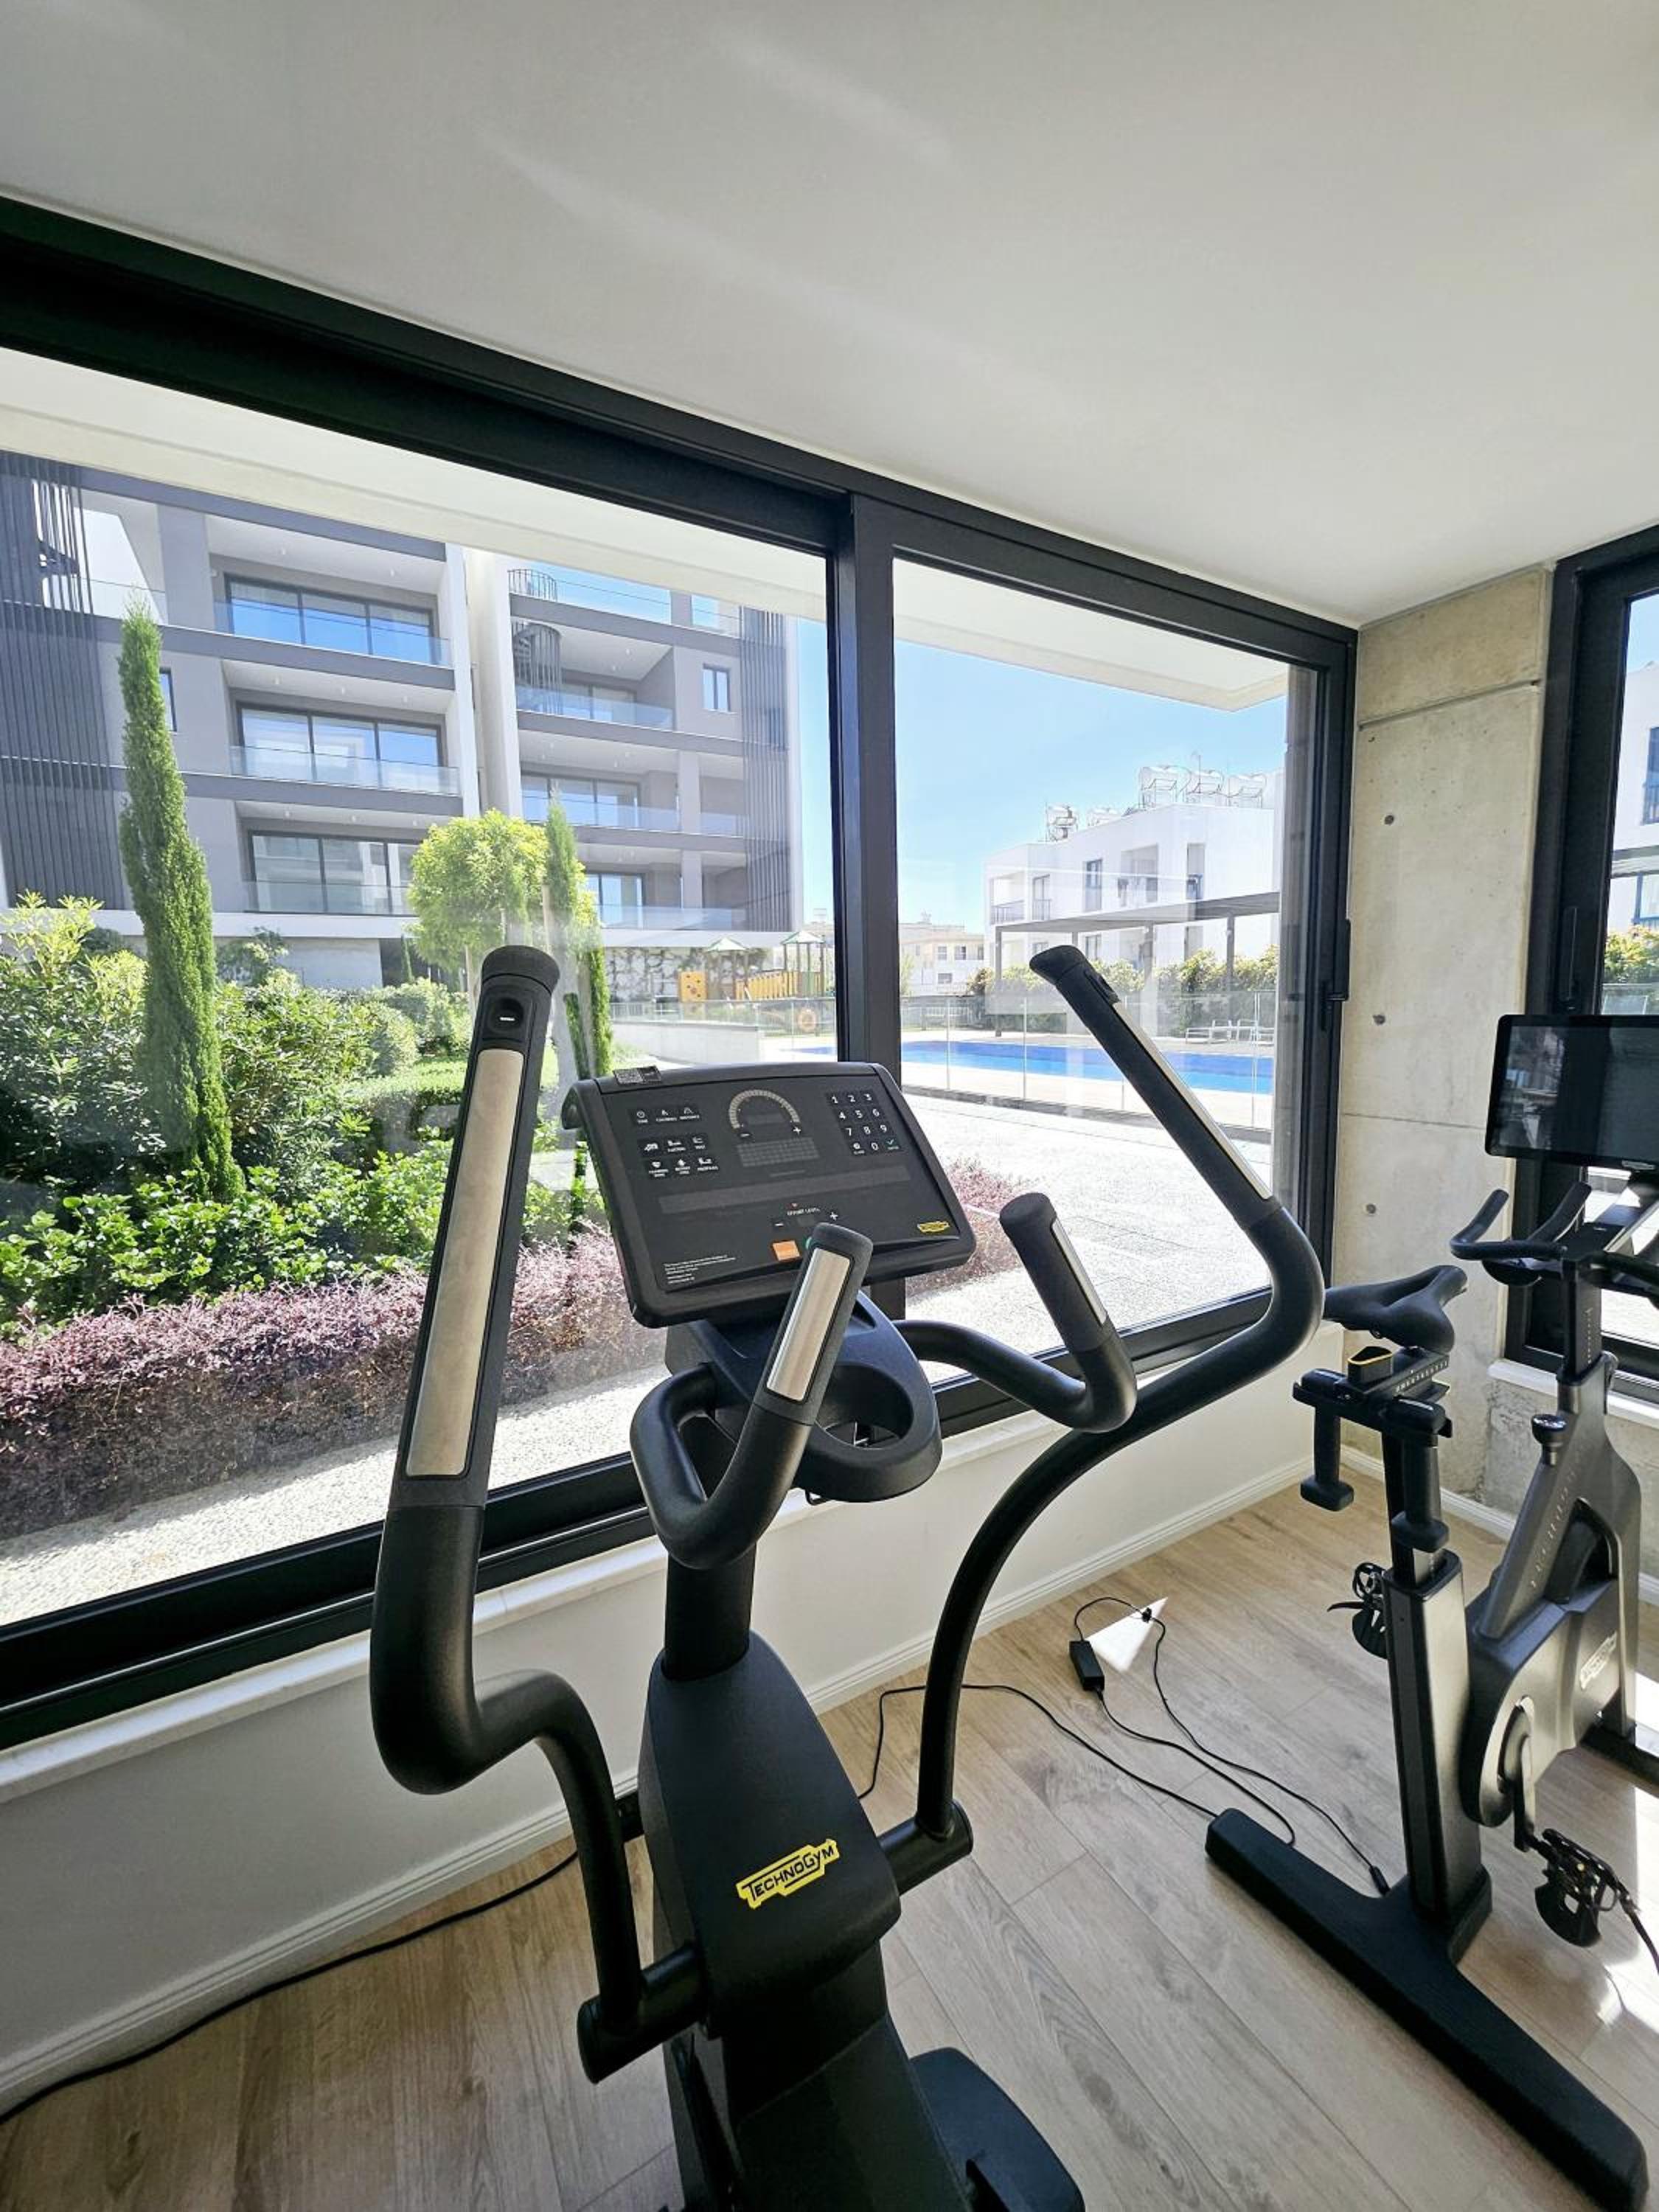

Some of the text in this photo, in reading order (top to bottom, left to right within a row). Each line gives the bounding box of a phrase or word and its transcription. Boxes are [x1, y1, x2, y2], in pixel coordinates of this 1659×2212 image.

[831, 1093, 872, 1104] 1 2 3
[838, 1108, 880, 1120] 4 5 6
[845, 1124, 888, 1136] 7 8 9
[871, 1142, 879, 1150] 0
[741, 1845, 835, 1902] TECHNOGYM
